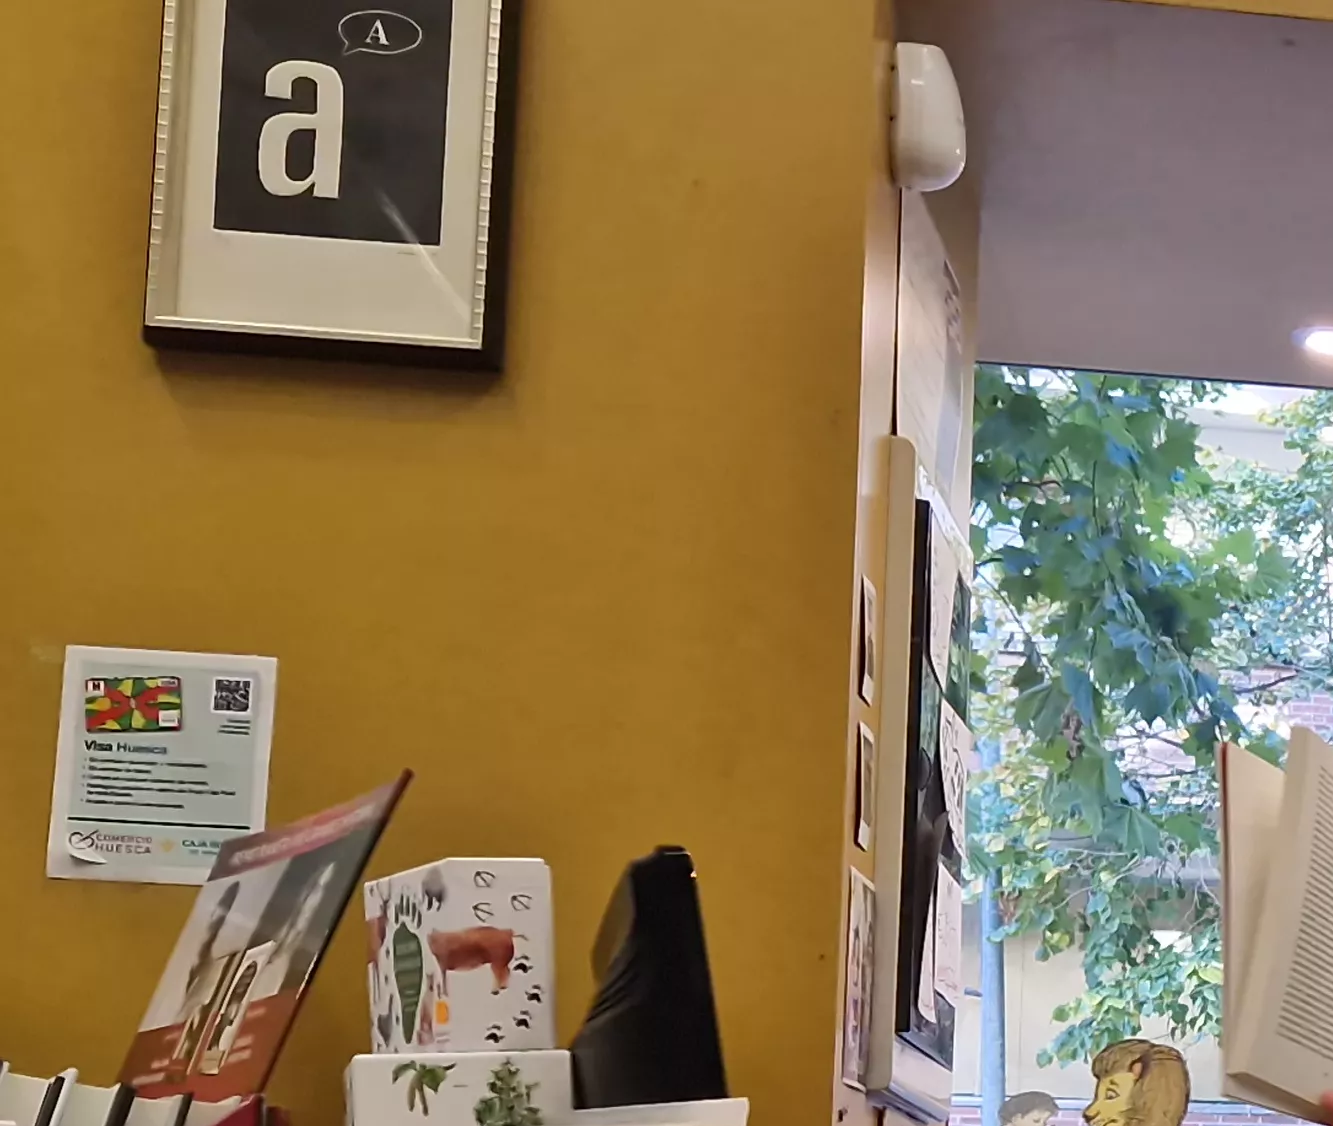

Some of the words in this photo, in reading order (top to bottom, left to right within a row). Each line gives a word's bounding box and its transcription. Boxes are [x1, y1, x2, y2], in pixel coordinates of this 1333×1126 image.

[365, 19, 390, 46] A
[258, 60, 344, 199] a
[84, 740, 113, 752] Visa
[95, 844, 151, 854] HUESCA
